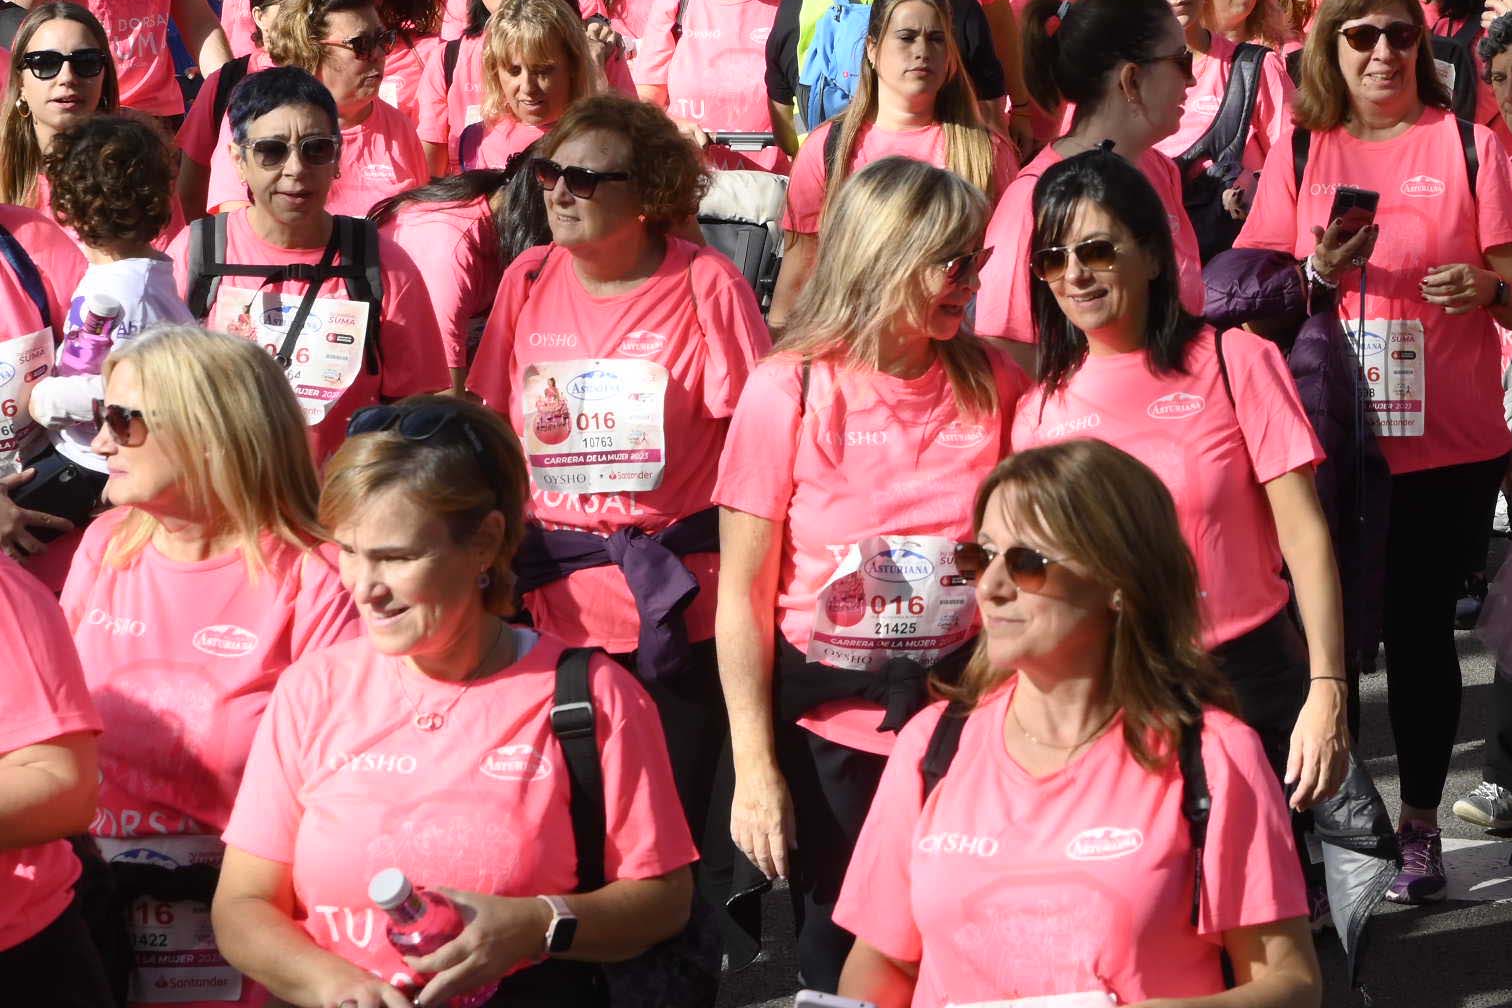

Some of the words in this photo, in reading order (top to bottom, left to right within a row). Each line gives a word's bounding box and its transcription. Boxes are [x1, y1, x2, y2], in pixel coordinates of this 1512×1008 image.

[678, 99, 705, 119] TU
[529, 332, 577, 347] OYSHO
[1152, 401, 1201, 415] ASTURIANA
[576, 412, 616, 431] 016
[583, 436, 613, 449] 10763
[544, 456, 584, 465] CARRERA
[587, 455, 597, 463] DE
[608, 453, 629, 462] MUJER
[544, 472, 586, 485] OYSHO
[869, 560, 929, 575] ASTURIANA
[870, 594, 925, 616] 016
[875, 622, 917, 635] 21425
[830, 638, 875, 648] CARRERA
[904, 638, 937, 648] MUJER
[823, 647, 873, 665] OYSHO
[134, 902, 175, 926] 16
[315, 904, 374, 949] TU
[169, 975, 228, 988] Santander
